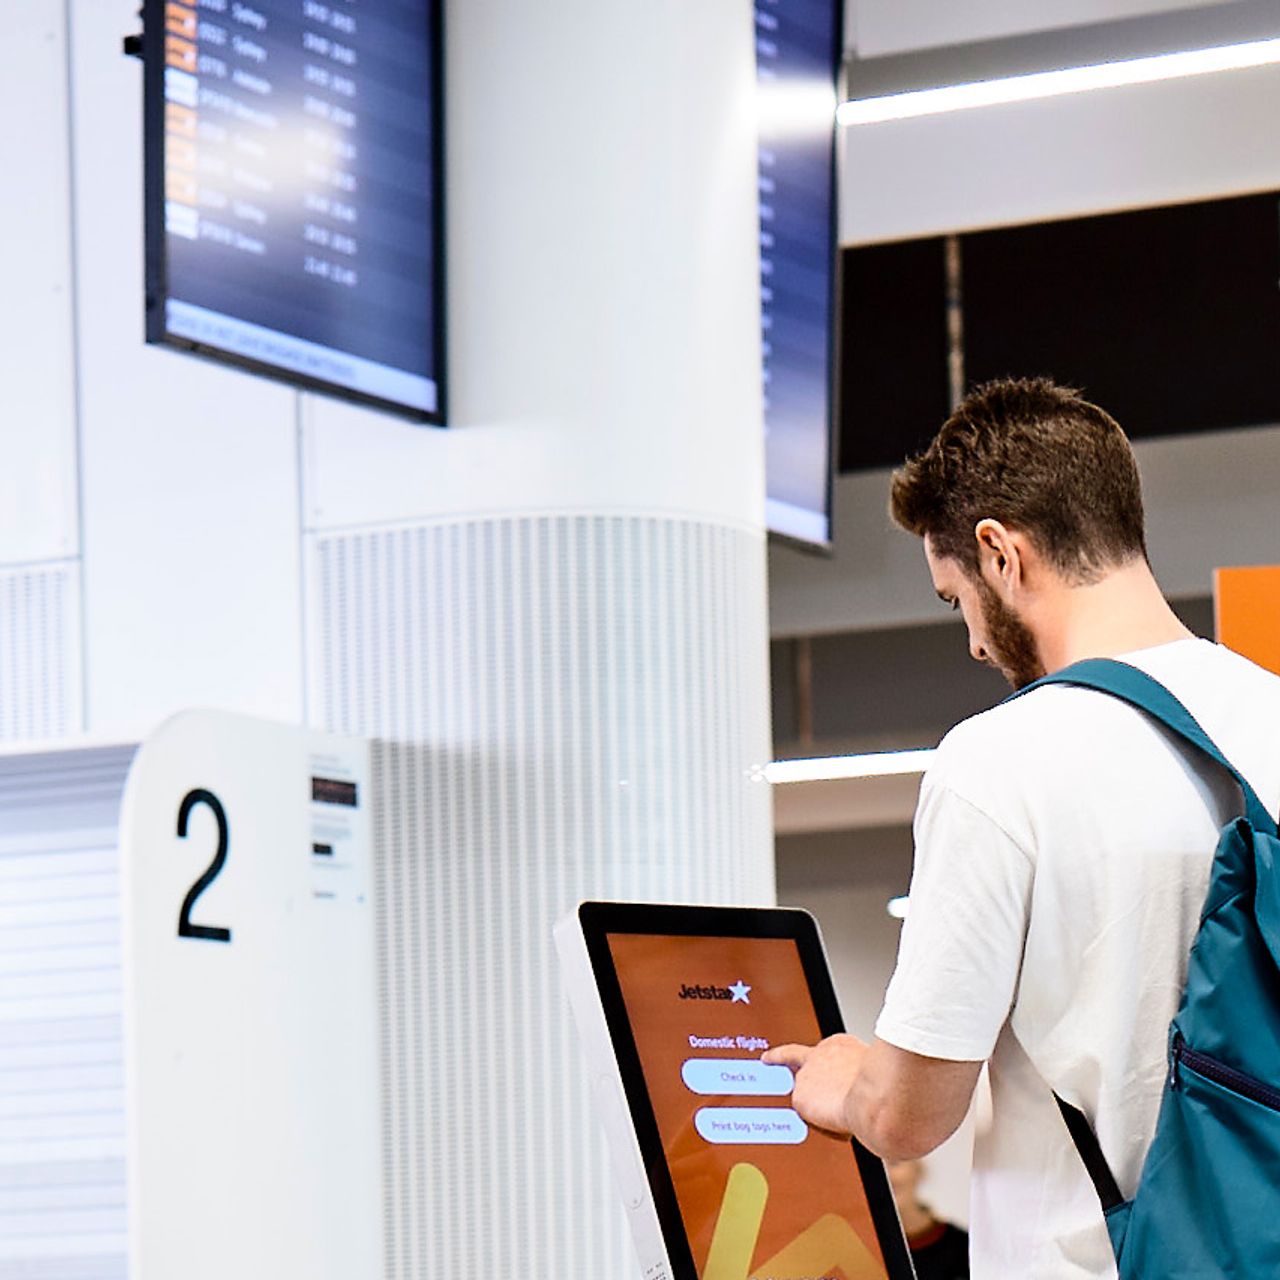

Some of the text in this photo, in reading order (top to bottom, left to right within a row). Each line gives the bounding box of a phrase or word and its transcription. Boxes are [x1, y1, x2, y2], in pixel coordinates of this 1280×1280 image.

[176, 788, 231, 941] 2
[688, 1035, 736, 1049] Domestic
[720, 1071, 746, 1083] Check
